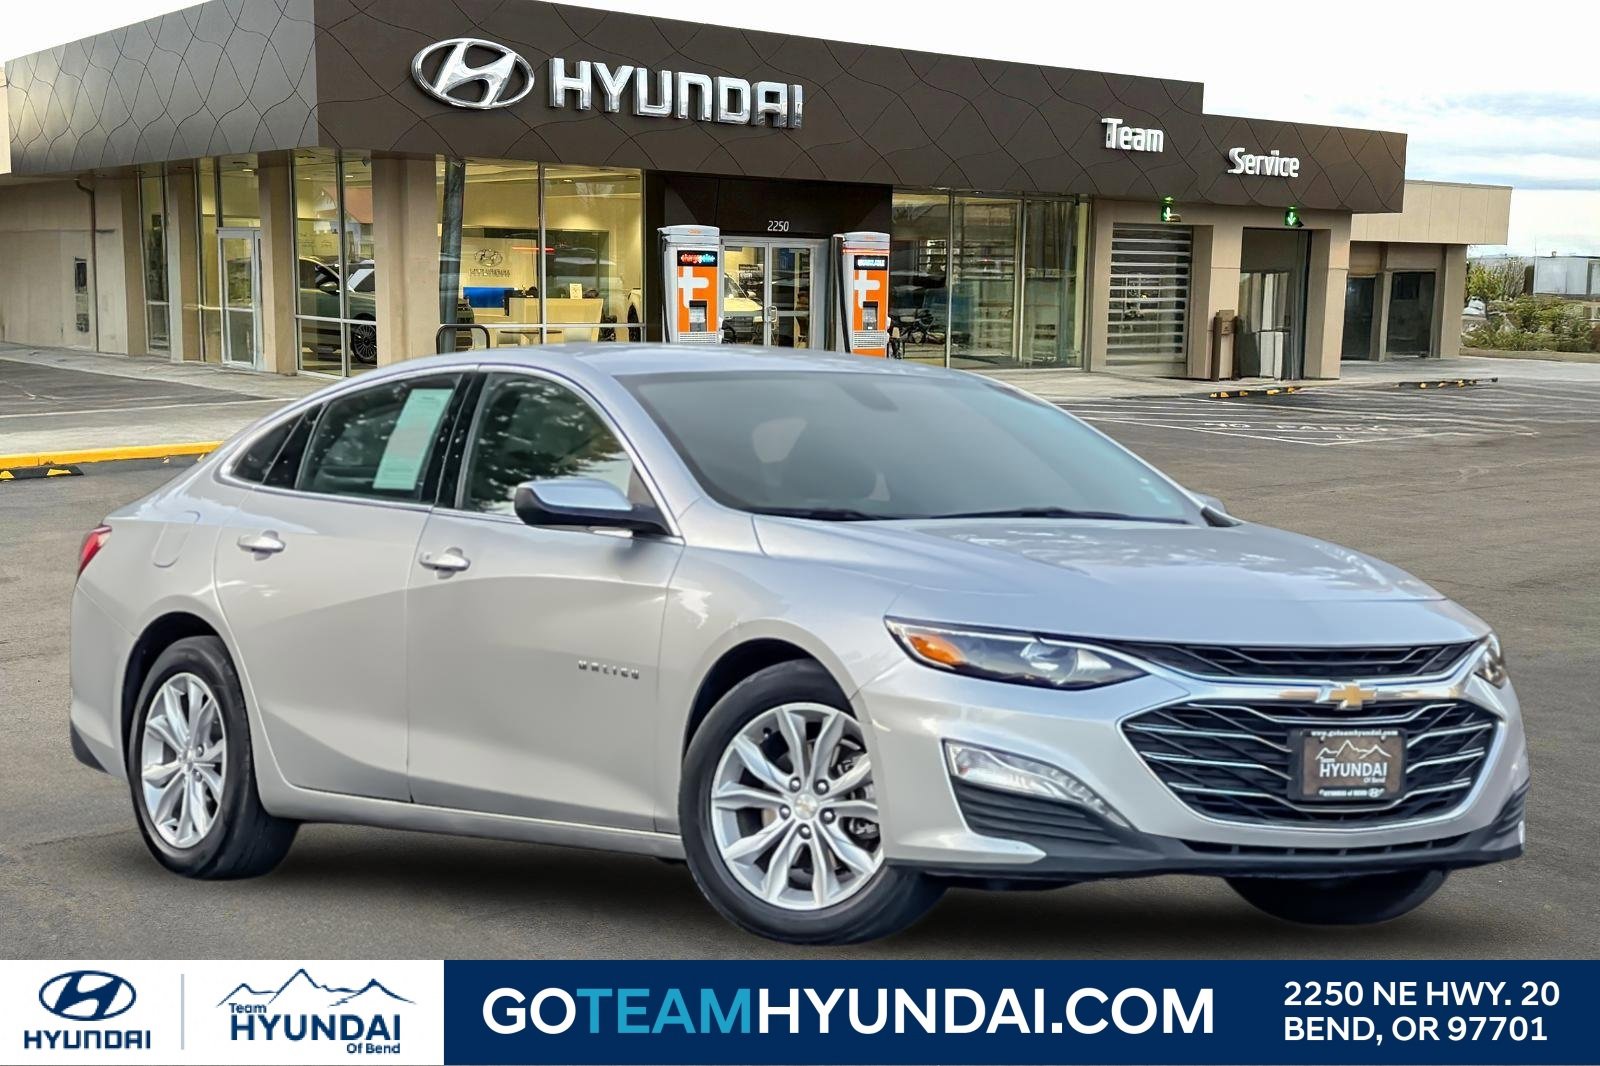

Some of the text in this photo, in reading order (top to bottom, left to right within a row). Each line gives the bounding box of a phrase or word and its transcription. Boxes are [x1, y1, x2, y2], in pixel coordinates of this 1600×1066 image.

[549, 57, 803, 129] HYUNDAI
[1101, 118, 1164, 153] Team
[1227, 147, 1300, 178] Service
[767, 220, 790, 232] 2250
[1320, 762, 1388, 778] HYUNDAI
